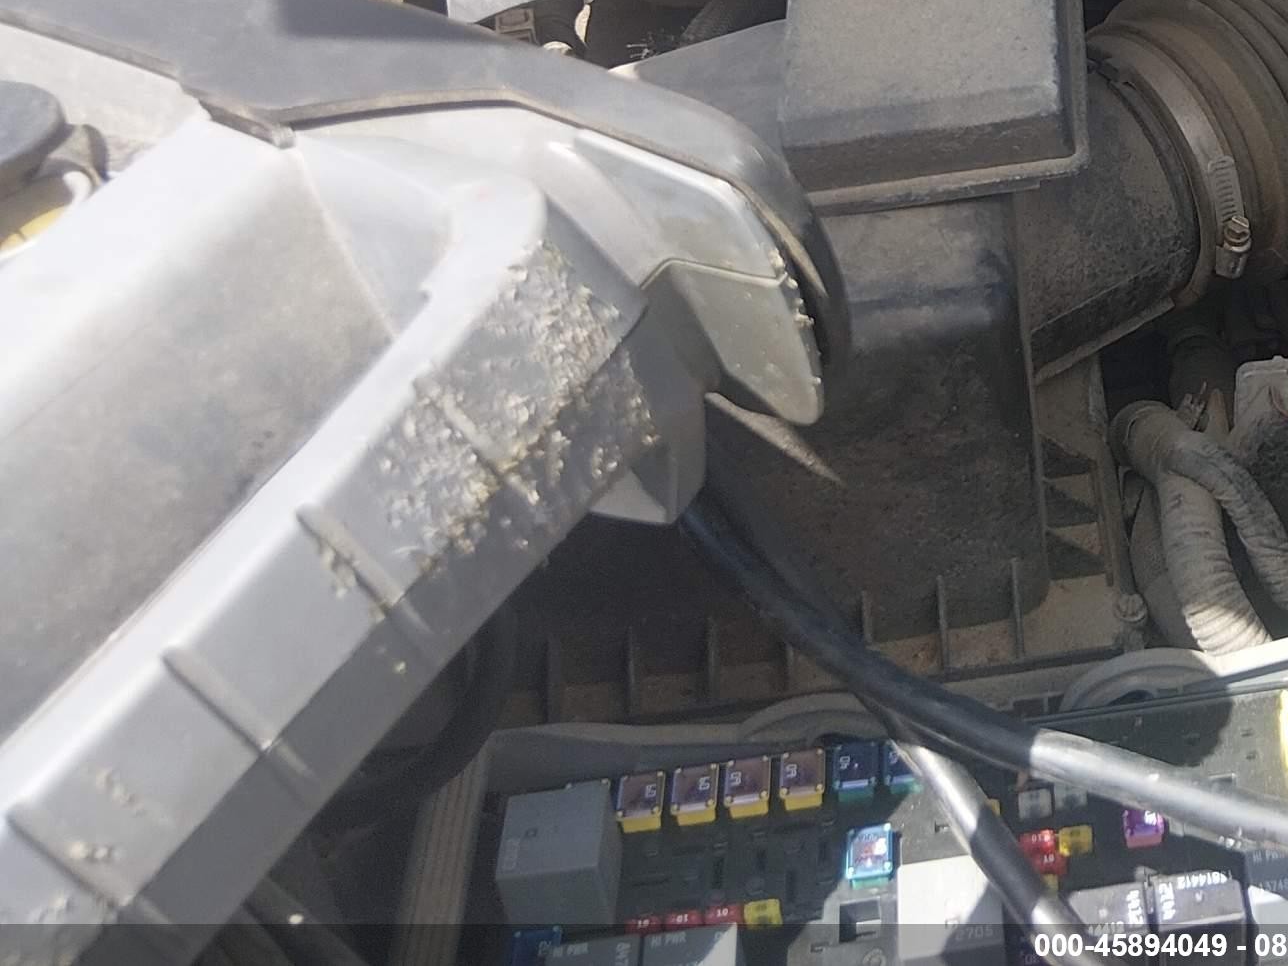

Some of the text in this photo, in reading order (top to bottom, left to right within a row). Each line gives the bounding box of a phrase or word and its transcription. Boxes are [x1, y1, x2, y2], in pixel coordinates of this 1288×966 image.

[716, 908, 729, 917] 10
[651, 931, 687, 947] HI PWR
